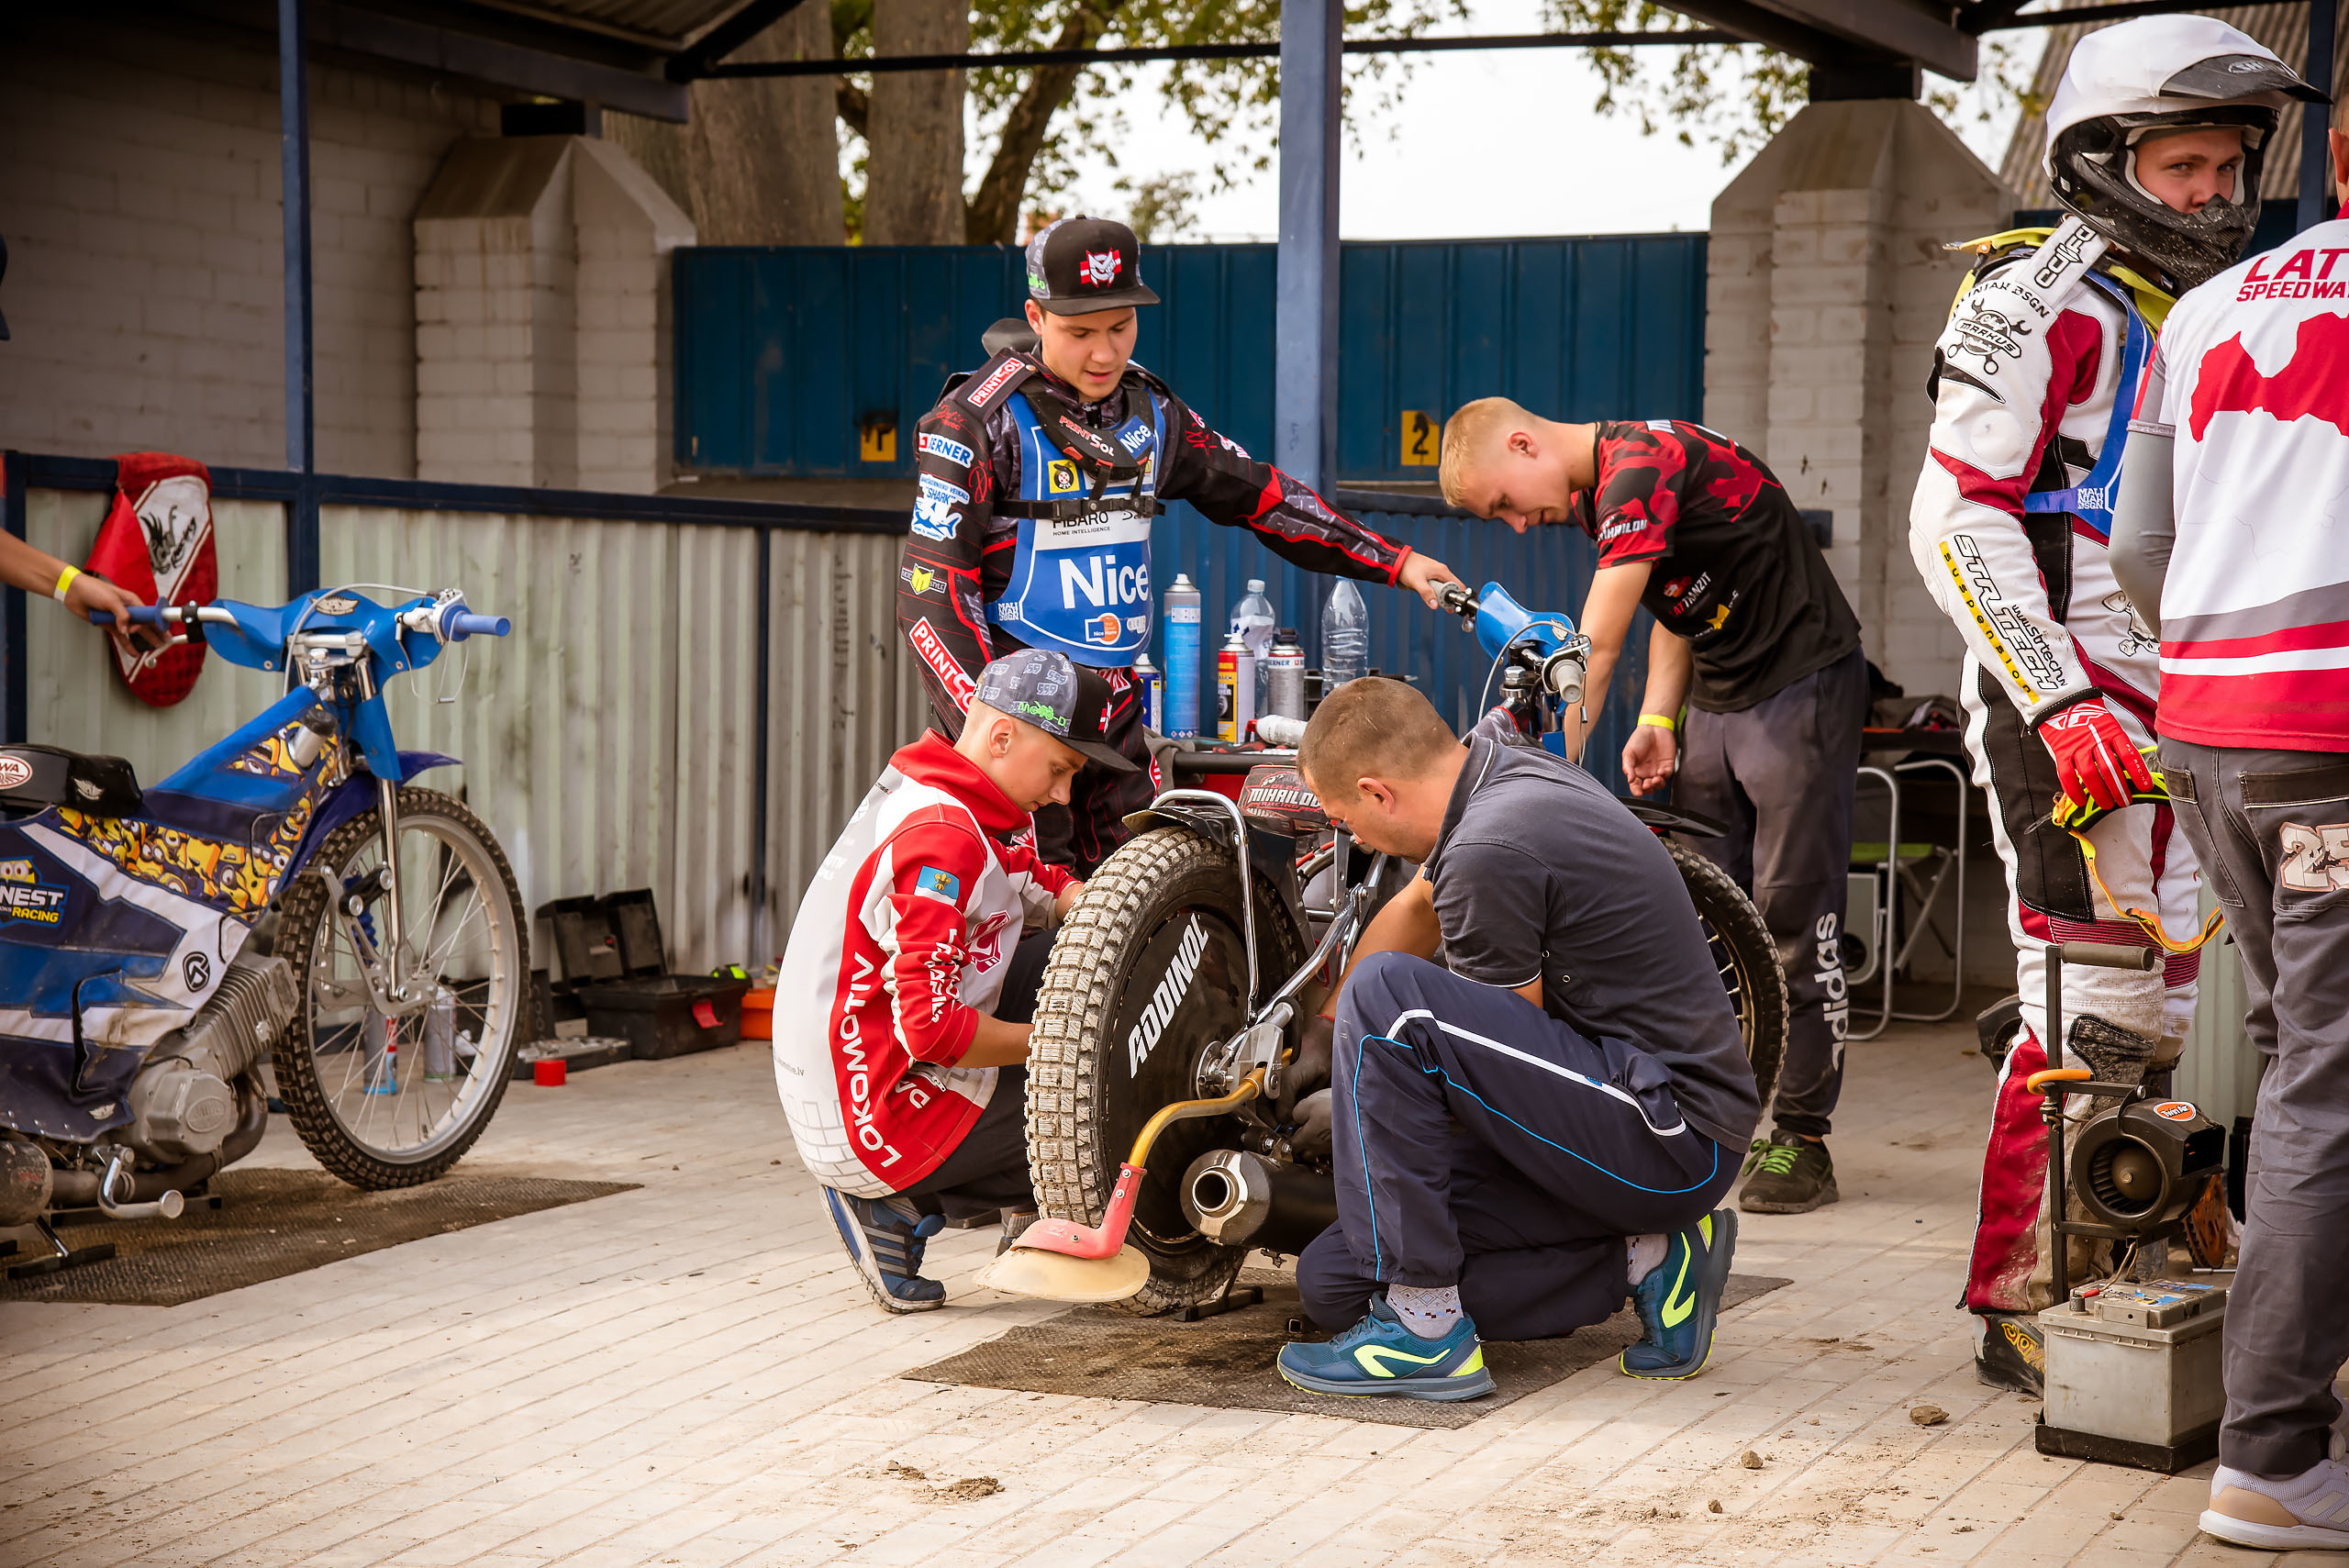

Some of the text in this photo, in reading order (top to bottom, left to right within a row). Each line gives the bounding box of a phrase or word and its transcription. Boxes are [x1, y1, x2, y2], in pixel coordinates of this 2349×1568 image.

[2236, 282, 2349, 302] SPEEDWA
[1960, 322, 2016, 351] MARKUS
[1059, 416, 1115, 457] PRINTSOL
[1120, 425, 1152, 453] Nice
[1412, 413, 1430, 455] 2
[1072, 527, 1110, 535] INTELLIGENCE
[1059, 554, 1149, 609] Nice
[914, 624, 974, 708] PRINTSO
[12, 906, 59, 923] RACING
[841, 951, 903, 1168] LOKOMOTIV
